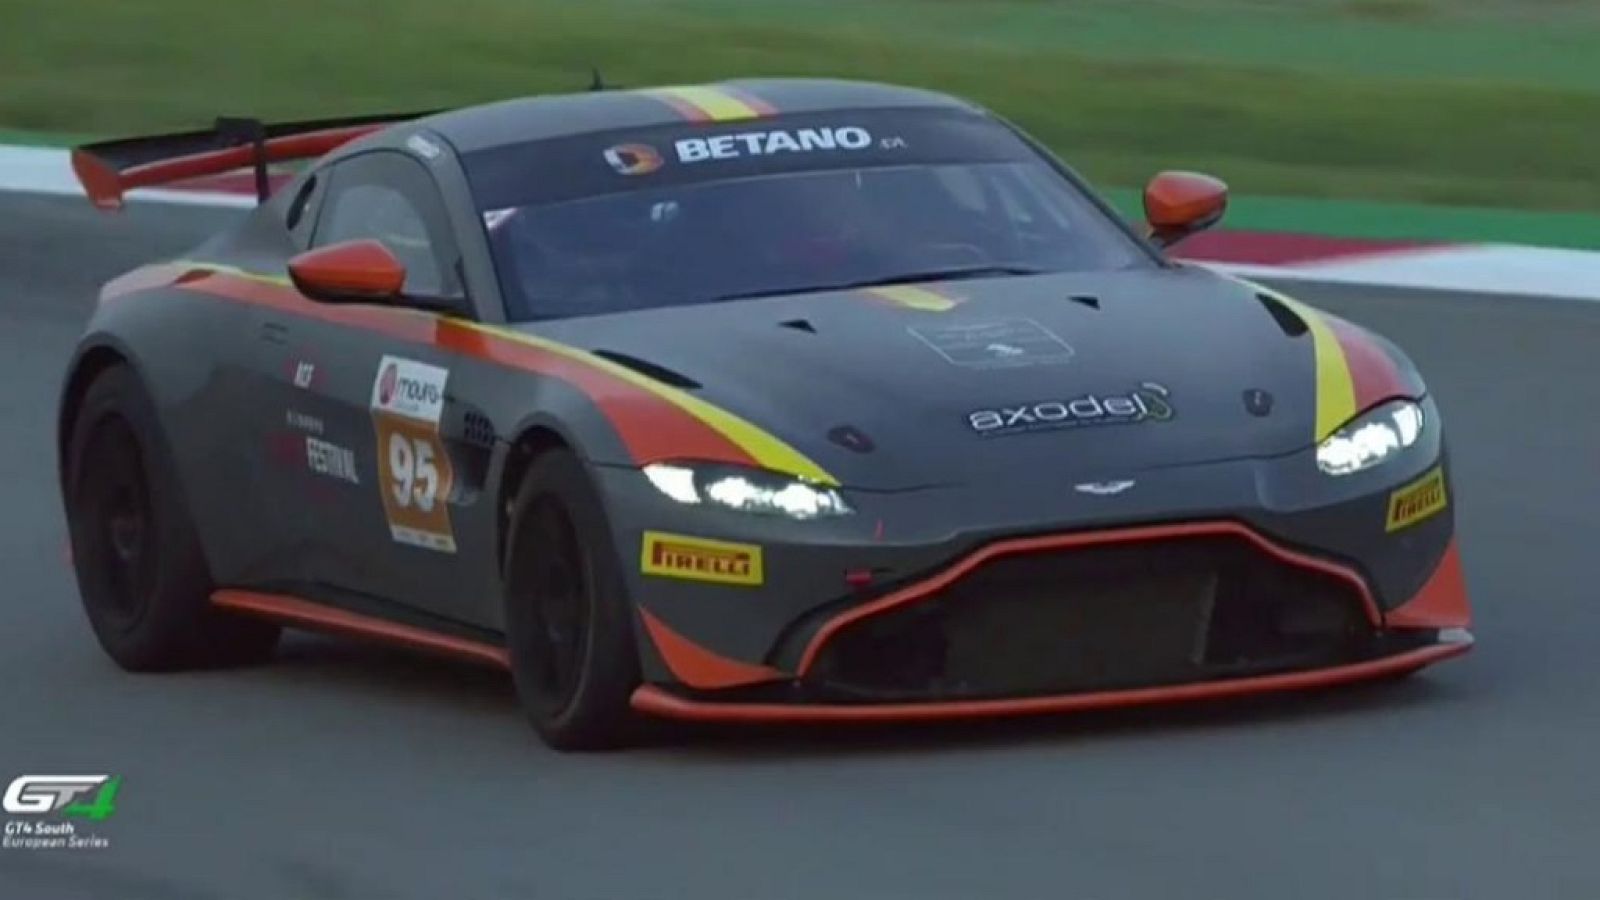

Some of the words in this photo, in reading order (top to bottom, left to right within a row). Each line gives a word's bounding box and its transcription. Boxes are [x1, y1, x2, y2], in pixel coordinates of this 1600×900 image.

[676, 126, 872, 163] BETANO
[389, 432, 439, 513] 95
[1392, 477, 1441, 522] PIRELLI
[652, 541, 750, 576] PIRELLI
